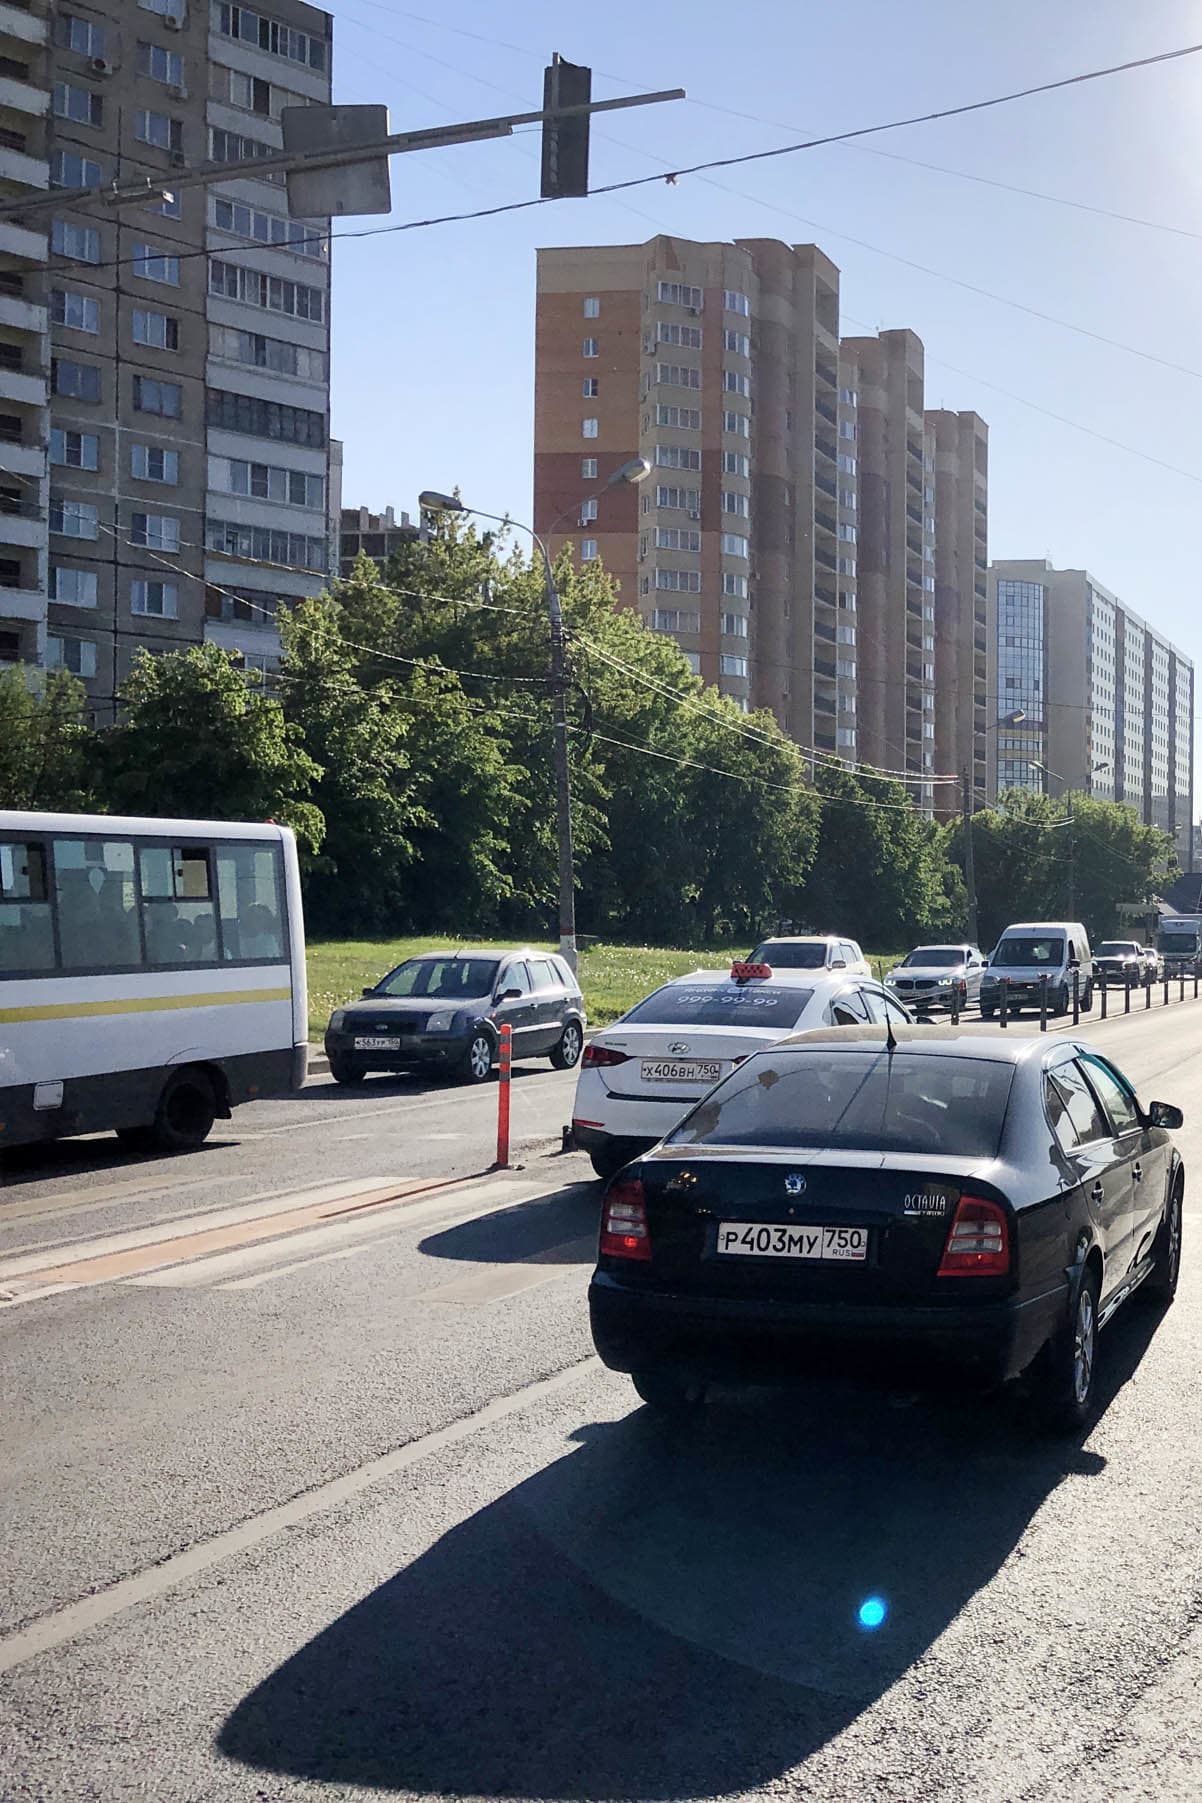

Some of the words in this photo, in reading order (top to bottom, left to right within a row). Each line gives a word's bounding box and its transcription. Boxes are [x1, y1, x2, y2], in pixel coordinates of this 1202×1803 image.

[677, 995, 778, 1007] 999-99-99
[697, 1064, 716, 1075] 750
[904, 1194, 946, 1210] OCTAVIA
[725, 1227, 818, 1254] Р403МУ
[825, 1229, 862, 1249] 750
[832, 1248, 851, 1257] RUS
